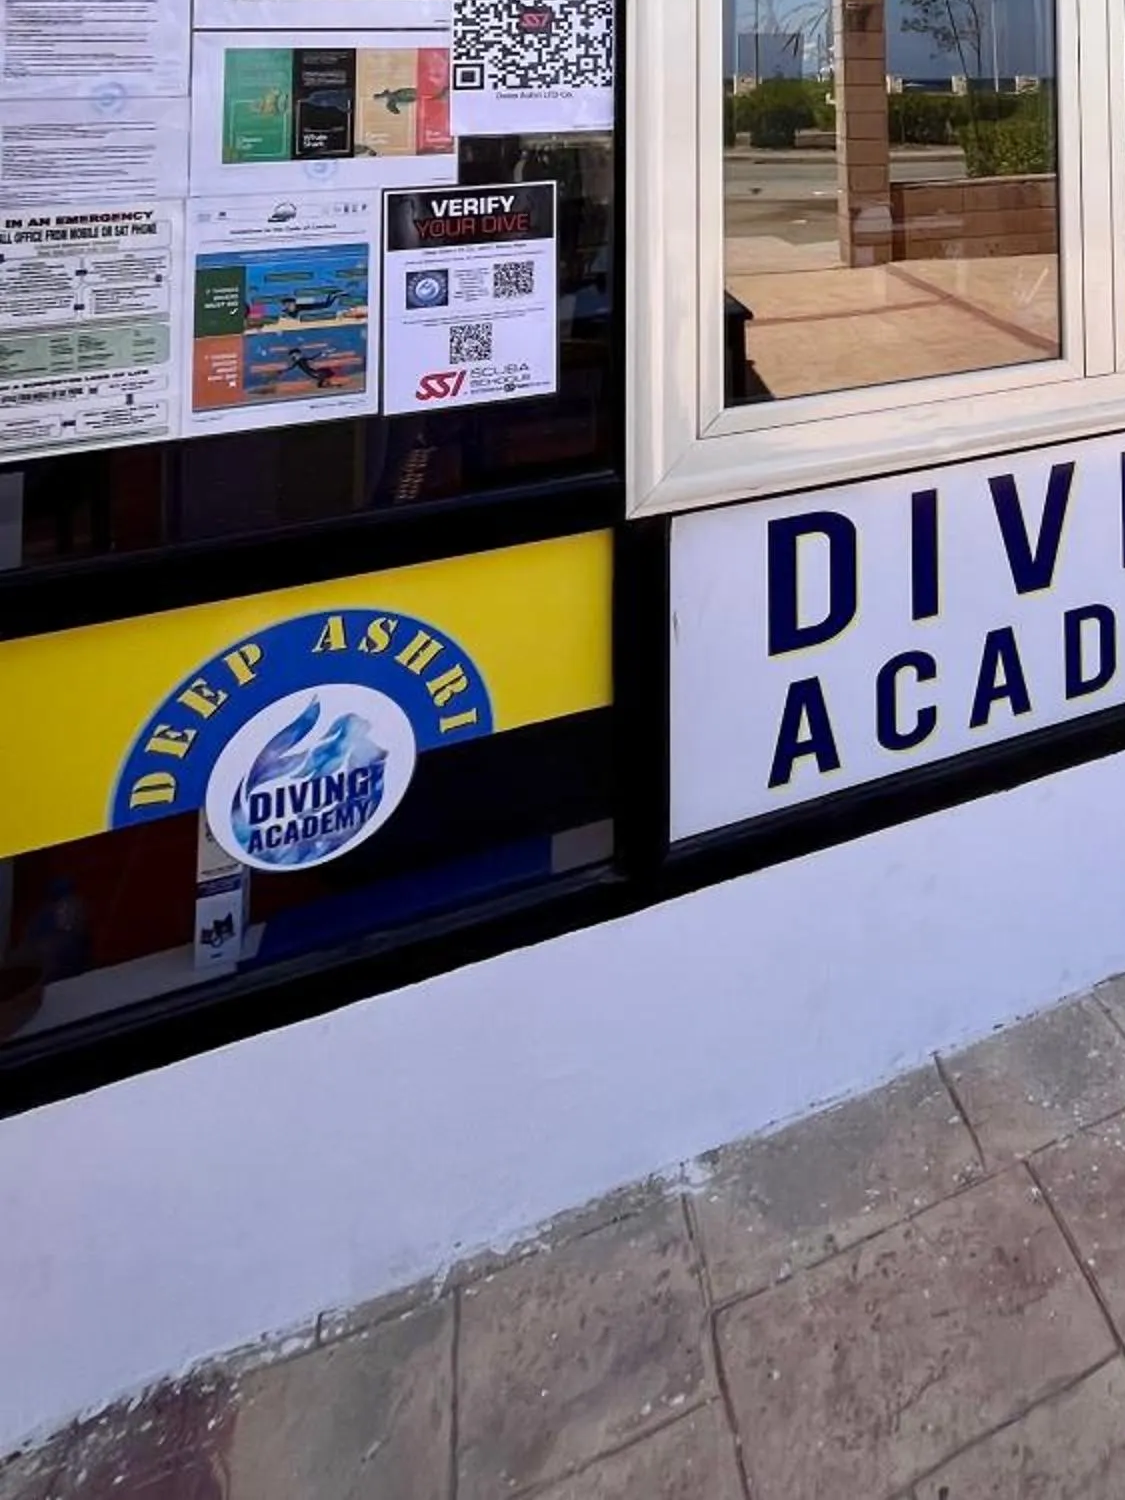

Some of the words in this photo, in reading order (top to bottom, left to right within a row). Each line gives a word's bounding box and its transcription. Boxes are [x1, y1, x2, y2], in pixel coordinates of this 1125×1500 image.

[521, 12, 550, 28] SSI
[431, 195, 515, 218] VERIFY
[5, 218, 23, 229] IN
[27, 216, 52, 228] AN
[55, 211, 154, 226] EMERGENCY
[416, 217, 476, 239] YOUR
[481, 213, 530, 234] DIVE
[14, 230, 43, 244] OFFICE
[45, 228, 68, 241] FROM
[69, 226, 99, 240] MOBILE
[470, 362, 529, 379] SCUBA
[415, 369, 467, 401] SSI
[130, 642, 264, 810] DEEP
[312, 615, 480, 734] ASHRI
[248, 762, 386, 826] DIVING
[246, 799, 378, 855] ACADEMY
